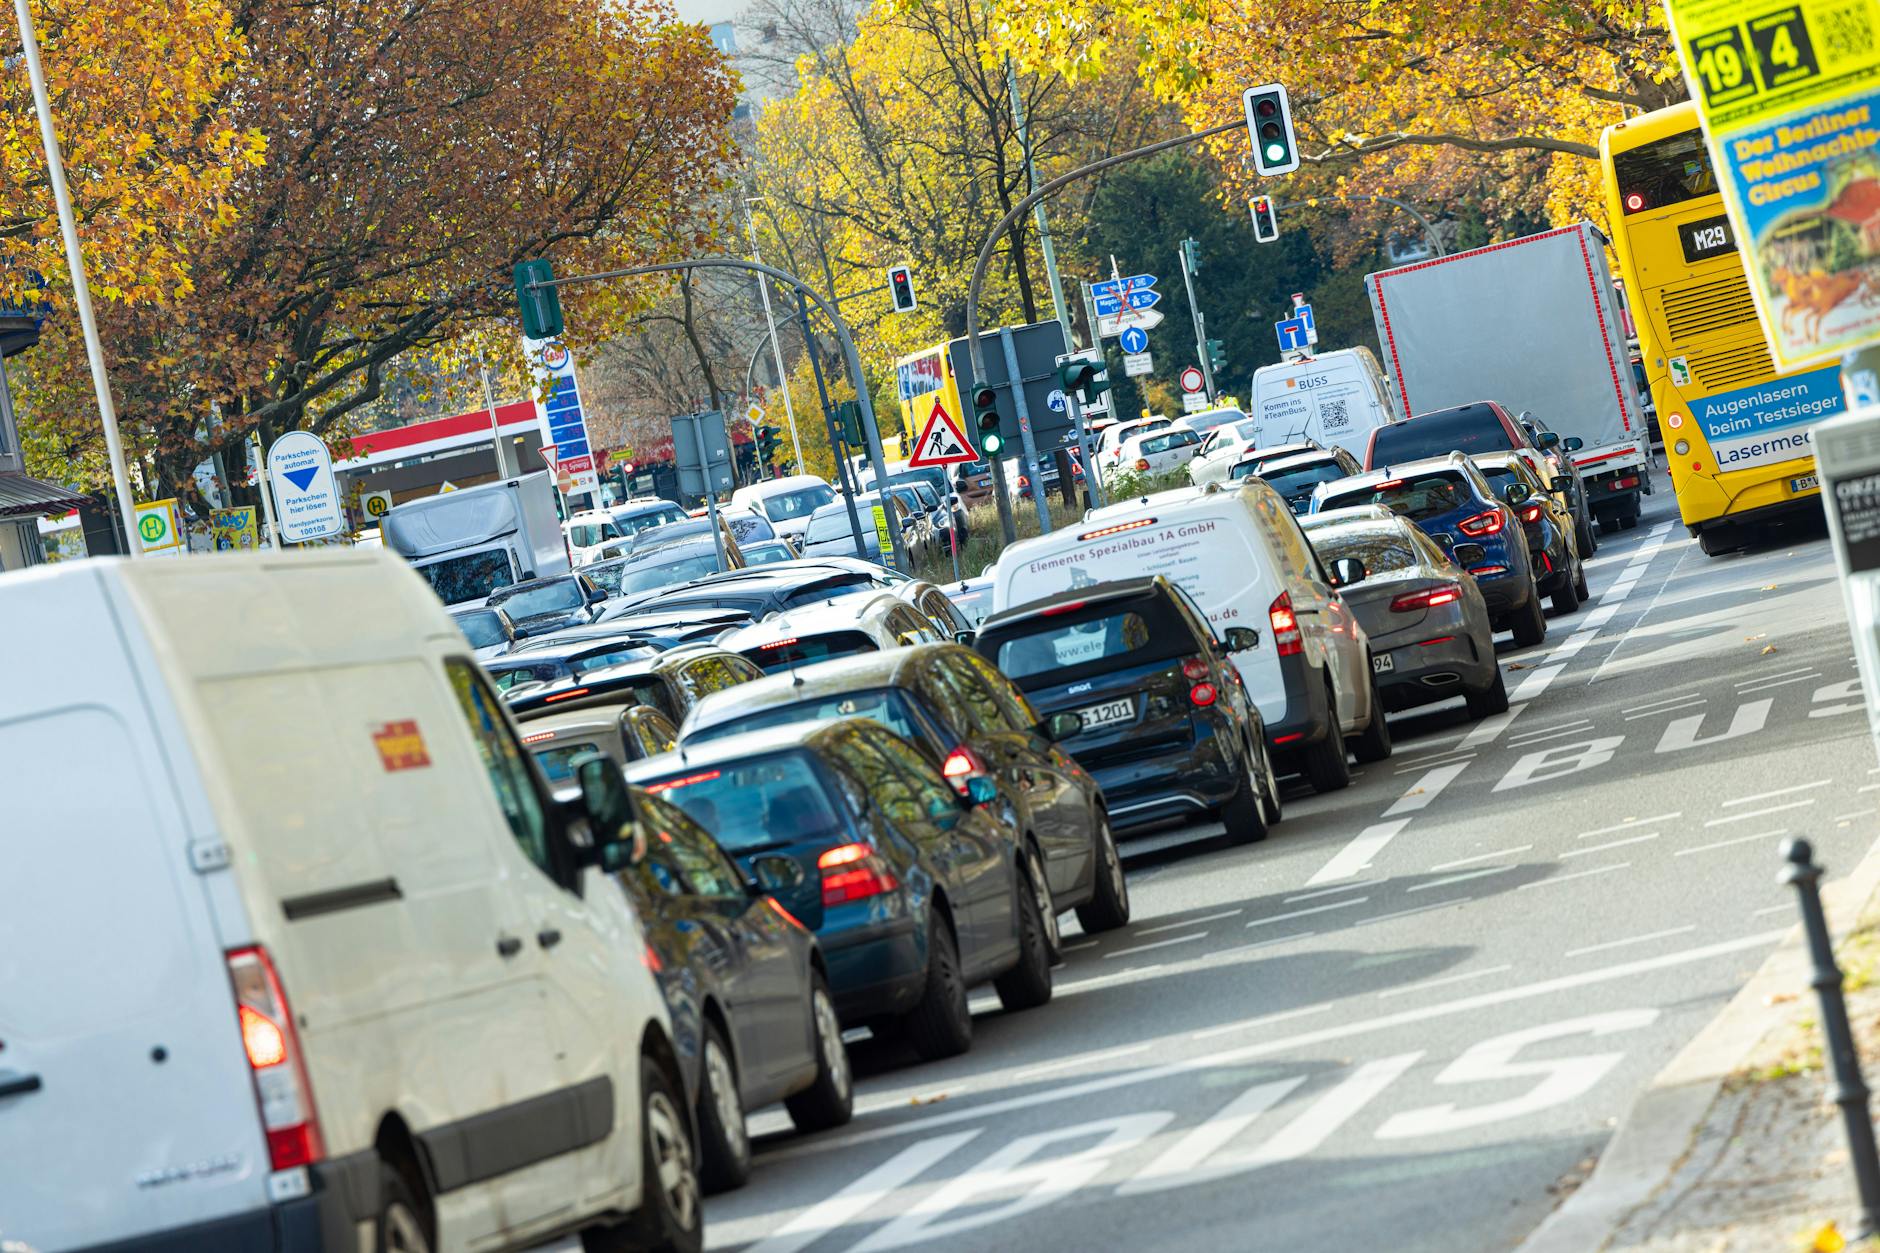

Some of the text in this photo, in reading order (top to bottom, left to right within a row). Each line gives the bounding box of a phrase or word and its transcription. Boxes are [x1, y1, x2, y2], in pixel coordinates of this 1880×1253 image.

[1771, 25, 1799, 68] 4
[1698, 44, 1743, 93] 19
[1734, 105, 1870, 162] Der Berliner
[1748, 171, 1821, 206] Circus
[1693, 225, 1727, 251] M29
[1299, 376, 1328, 390] BUSS
[1264, 398, 1302, 412] Komm ins
[1705, 383, 1808, 418] Augenlasern
[1264, 406, 1307, 420] #TeamBuss
[1709, 396, 1838, 436] beim Testsieger
[275, 448, 320, 462] Parkschein-
[284, 458, 315, 469] automat
[286, 492, 327, 506] Parkschein
[290, 501, 327, 514] hier lösen
[1030, 522, 1216, 573] Elemente Spezialbau 1A GmbH
[1374, 655, 1391, 670] 94
[1068, 683, 1091, 694] smart
[1093, 702, 1132, 723] 1201
[1491, 678, 1867, 793] BUS
